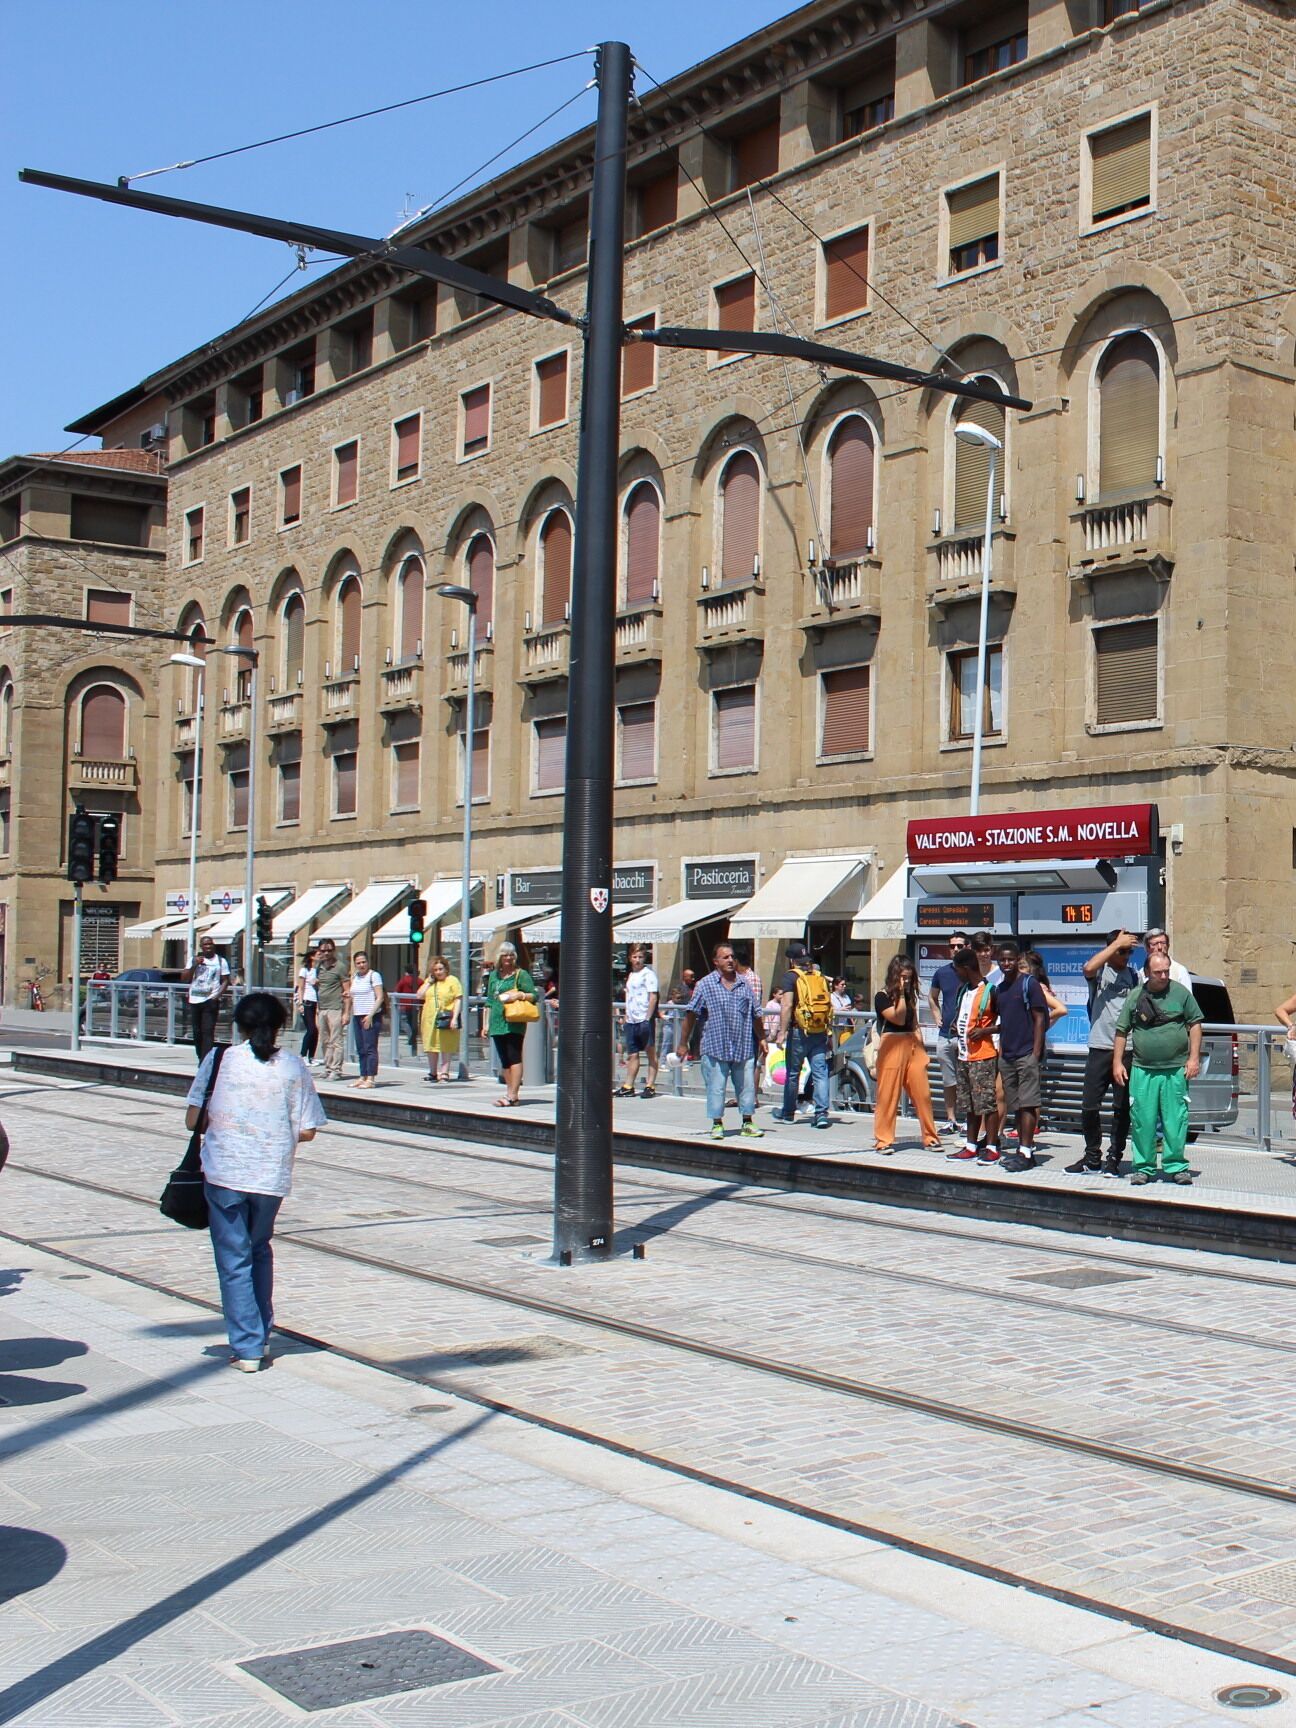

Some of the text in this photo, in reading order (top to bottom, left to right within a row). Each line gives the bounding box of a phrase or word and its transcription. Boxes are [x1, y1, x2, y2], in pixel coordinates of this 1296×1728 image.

[915, 831, 975, 850] VALFONDA
[985, 826, 1043, 846] STAZIONE
[1046, 825, 1073, 843] S.M.
[1077, 820, 1139, 841] NOVELLA
[693, 867, 749, 886] Pasticceria
[515, 877, 531, 893] Bar
[1065, 906, 1092, 922] 14 15
[1047, 962, 1083, 974] FIRENZE
